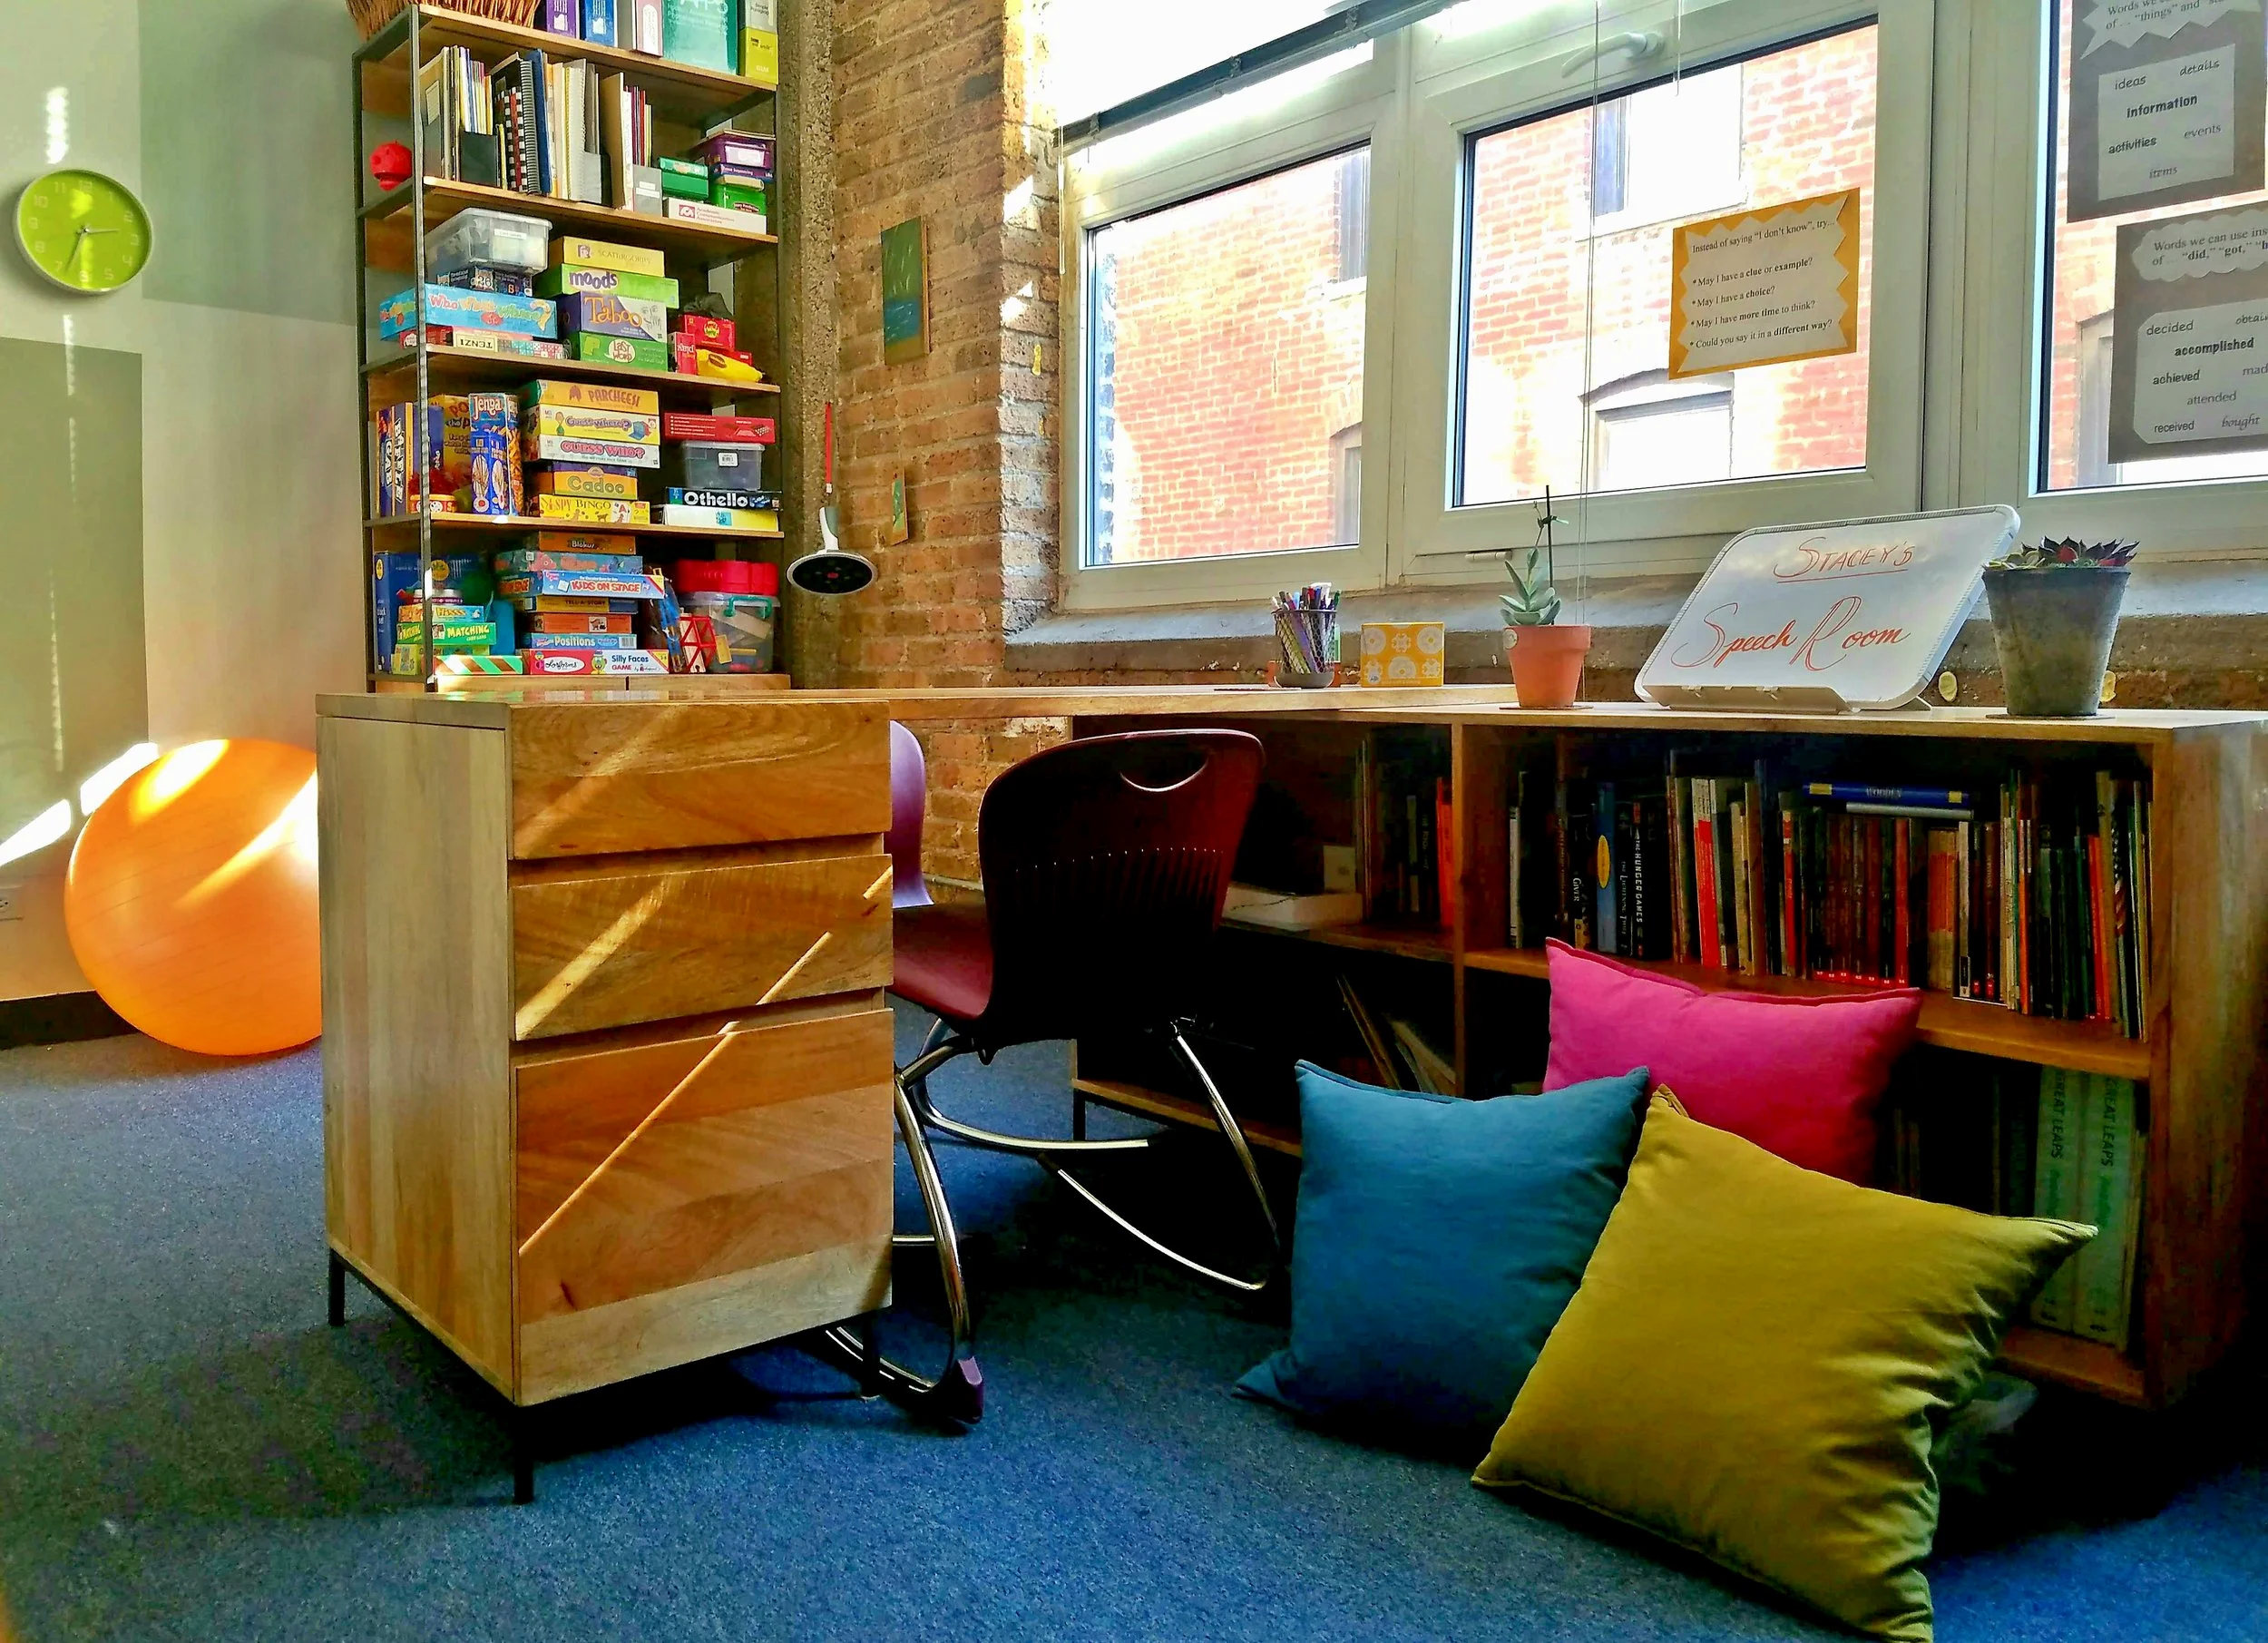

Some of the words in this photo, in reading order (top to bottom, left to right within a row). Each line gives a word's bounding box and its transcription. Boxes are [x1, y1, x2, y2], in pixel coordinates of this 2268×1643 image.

[2106, 19, 2117, 30] of
[2180, 0, 2200, 12] and
[2107, 2, 2138, 15] Words
[2179, 60, 2220, 76] details
[2115, 74, 2146, 90] ideas
[2184, 124, 2221, 138] events
[2108, 137, 2157, 154] activities
[2149, 165, 2177, 179] items
[1692, 240, 1718, 253] Instead
[1719, 239, 1729, 248] of
[1729, 234, 1753, 247] saying
[1764, 228, 1784, 239] don't
[2154, 237, 2186, 250] Words
[2190, 238, 2204, 246] we
[2208, 233, 2226, 244] can
[2230, 230, 2248, 240] use
[2152, 255, 2165, 266] of
[569, 271, 618, 289] moods
[1697, 277, 1715, 287] May
[1721, 272, 1738, 282] have
[1745, 267, 1763, 278] clue
[1774, 257, 1813, 272] example?
[1696, 298, 1714, 308] May
[1720, 294, 1738, 304] have
[1745, 285, 1775, 298] choice?
[583, 297, 643, 328] Taboo
[1696, 318, 1713, 328] May
[1720, 316, 1737, 325] have
[1739, 311, 1760, 321] more
[1761, 308, 1780, 317] time
[1781, 306, 1790, 314] to
[1791, 299, 1815, 313] think?
[1696, 337, 1718, 348] Could
[1719, 336, 1735, 347] you
[1735, 334, 1748, 344] say
[1750, 330, 1756, 339] it
[1757, 329, 1765, 338] in
[1774, 321, 1809, 337] different
[1811, 319, 1833, 331] way?
[2146, 319, 2194, 336] decided
[459, 337, 494, 349] TENZI
[2175, 337, 2254, 357] accomplished
[2153, 369, 2201, 385] achieved
[587, 389, 640, 407] PARCHEESI
[2186, 391, 2237, 406] attended
[473, 396, 504, 421] Jenga
[2154, 420, 2195, 434] received
[2222, 413, 2261, 431] bought
[561, 440, 604, 455] GUESS
[604, 444, 646, 459] WHO?
[567, 475, 625, 494] Cadoo
[555, 498, 572, 511] SPY
[576, 498, 611, 510] BINGO
[684, 491, 748, 508] Othello
[1774, 536, 1915, 579] STACEY'S
[598, 581, 611, 591] ON
[611, 582, 640, 592] STAGE
[447, 624, 490, 639] MATCHING
[1671, 602, 1797, 670] Speech
[1789, 595, 1911, 671] Room
[554, 635, 596, 648] Positions
[611, 654, 626, 664] Silly
[628, 654, 649, 663] Faces
[1634, 853, 1643, 892] HUNGER
[1572, 877, 1581, 902] GIVER
[1635, 893, 1643, 924] GAMES
[2050, 1117, 2065, 1159] LEAPS
[2100, 1125, 2116, 1167] LEAPS
